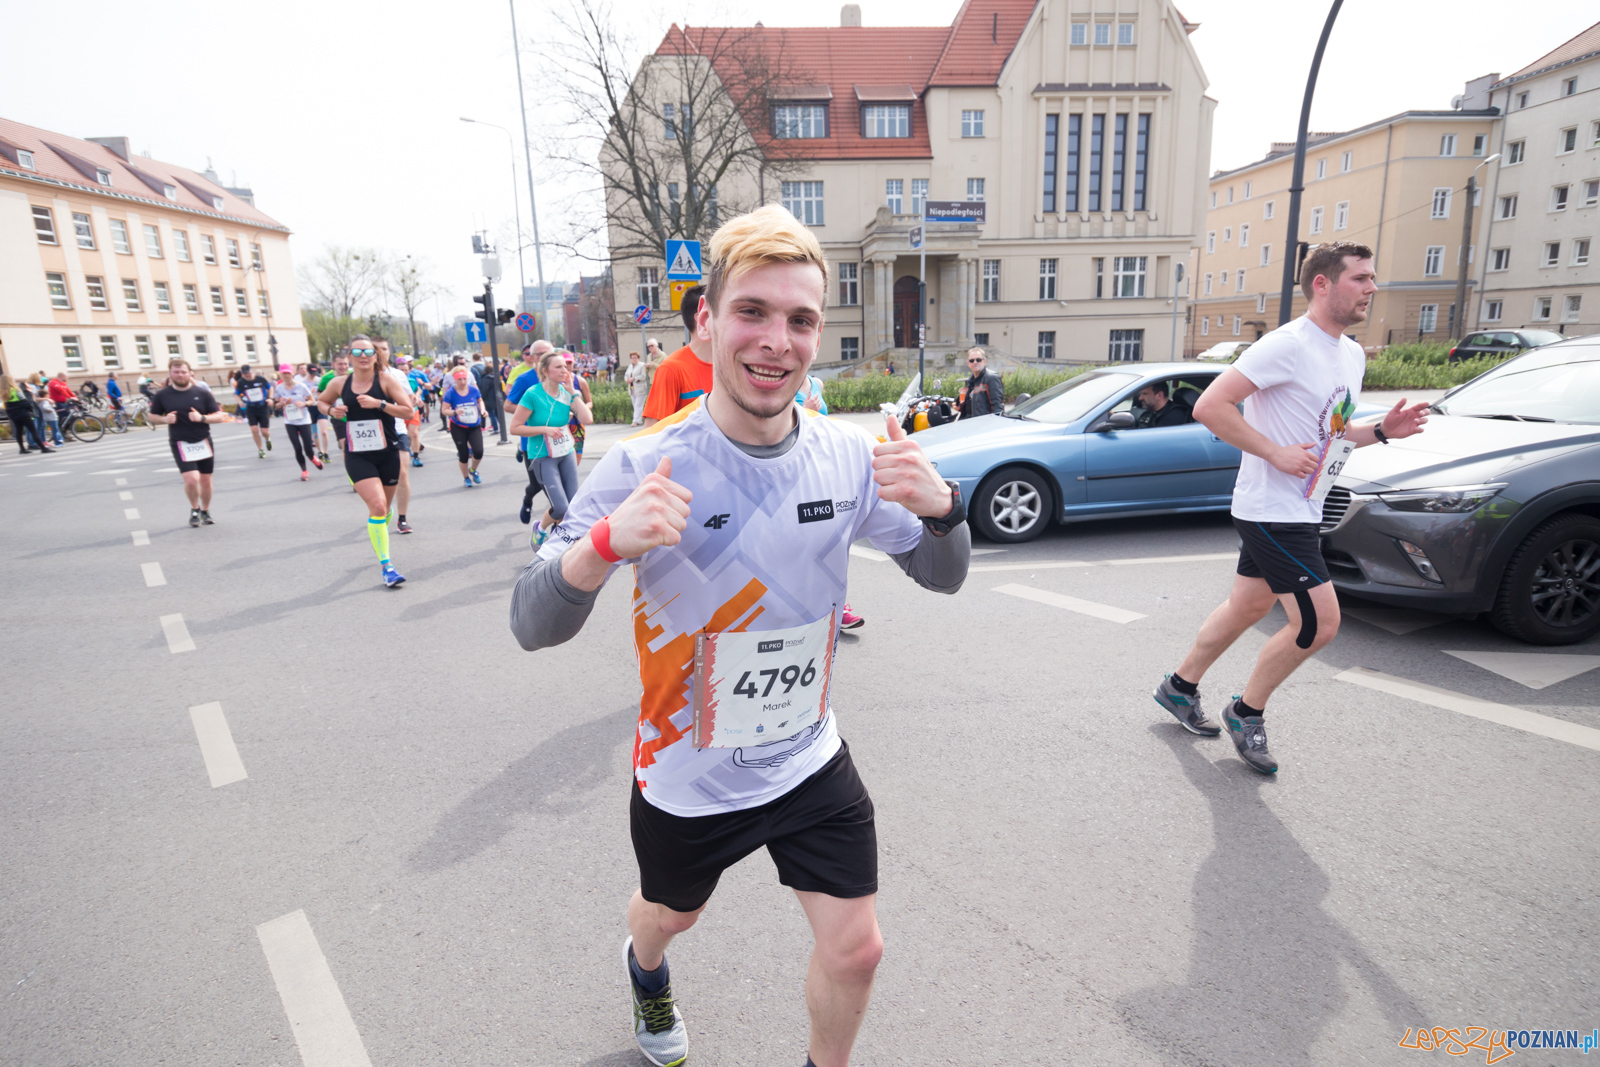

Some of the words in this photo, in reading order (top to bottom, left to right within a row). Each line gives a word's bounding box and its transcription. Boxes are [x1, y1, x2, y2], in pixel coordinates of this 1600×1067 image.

[929, 207, 983, 217] Niepodległości
[355, 429, 377, 438] 3621
[186, 444, 205, 453] 3709
[802, 508, 813, 517] 11.
[814, 504, 832, 516] PKO
[703, 513, 731, 530] 4F
[732, 657, 817, 699] 4796
[762, 699, 793, 712] Marek
